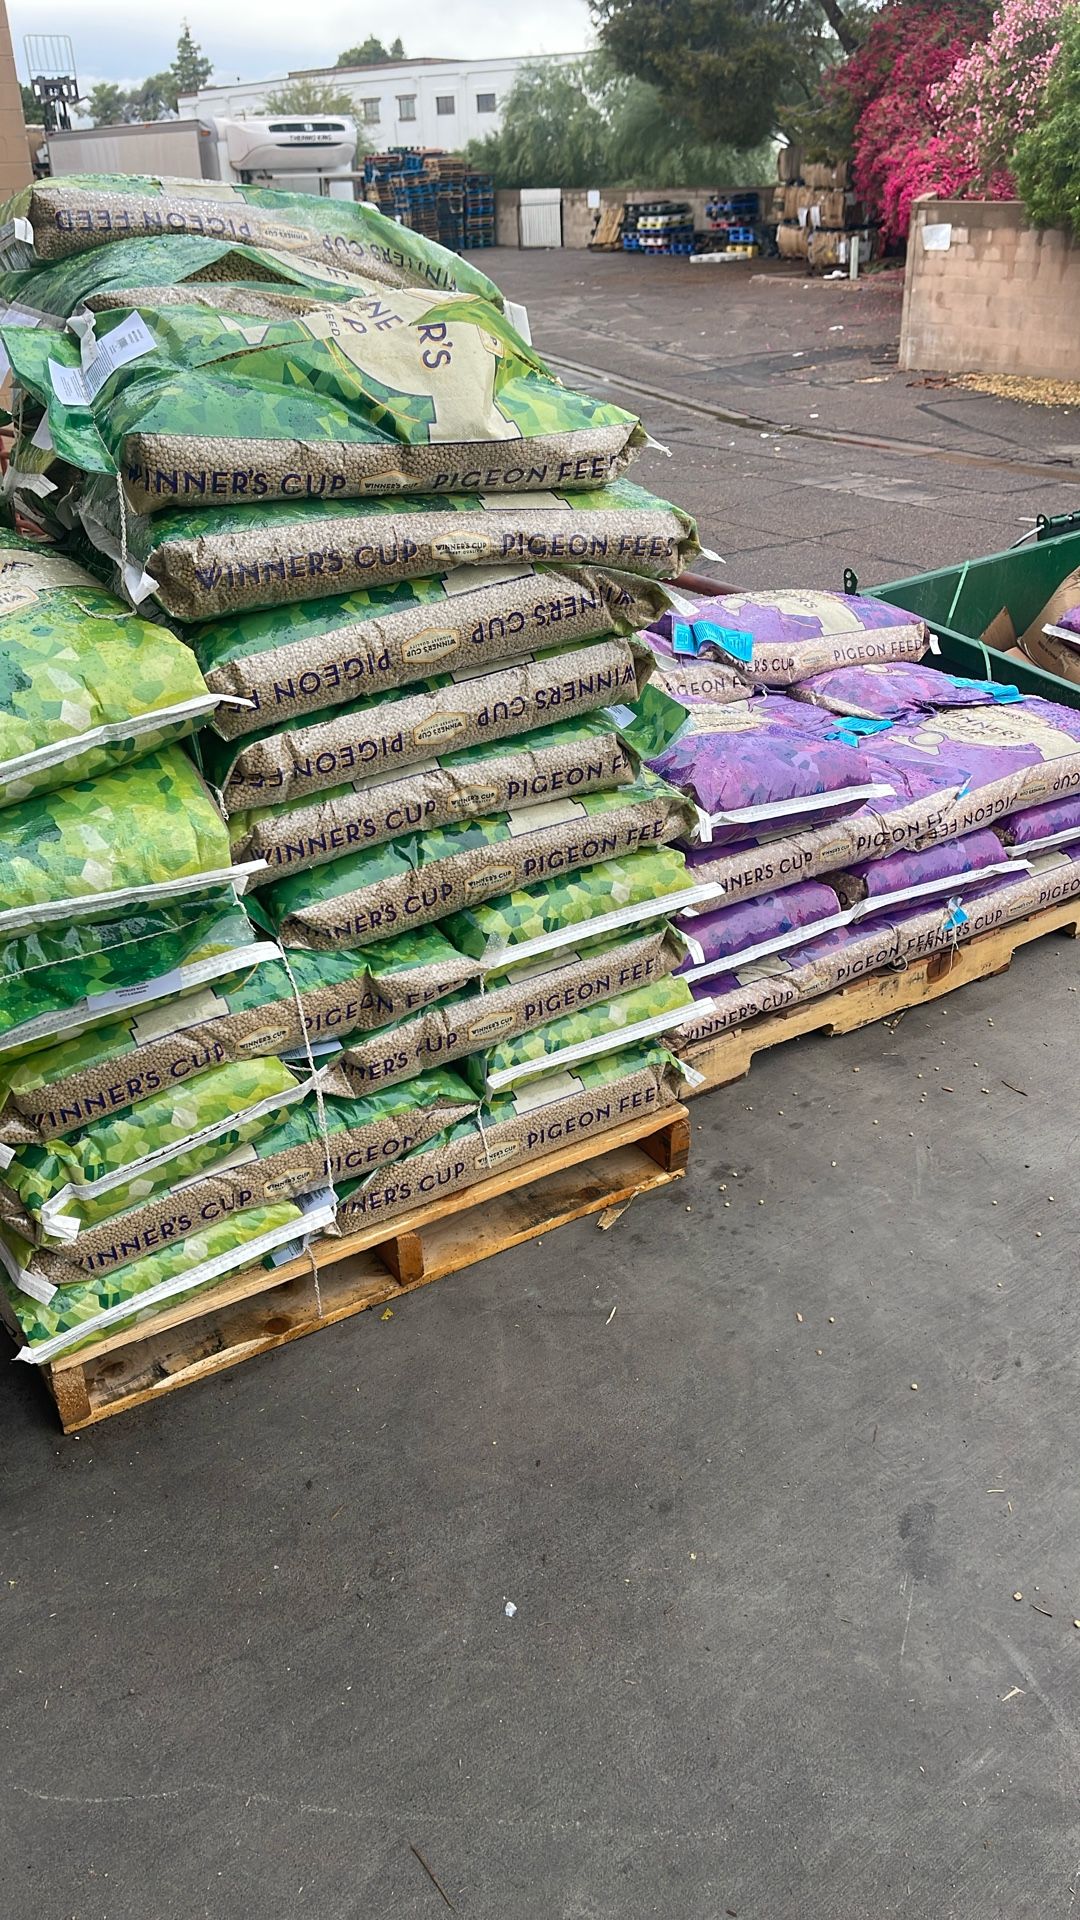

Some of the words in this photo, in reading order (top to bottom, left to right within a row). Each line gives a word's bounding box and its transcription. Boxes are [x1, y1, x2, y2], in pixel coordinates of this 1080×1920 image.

[55, 209, 130, 230] FEED
[143, 208, 251, 238] PIGEON
[322, 234, 364, 257] CUP
[128, 463, 268, 495] WINNER'S
[280, 473, 346, 495] CUP
[432, 464, 547, 489] PIGEON
[195, 545, 344, 590] WINNER'S
[354, 538, 418, 569] CUP
[502, 534, 607, 557] PIGEON
[471, 611, 525, 643] CUP
[406, 648, 422, 658] CUP
[423, 638, 457, 653] WINNER'S
[772, 658, 795, 671] CUP
[834, 644, 885, 662] PIGEON
[891, 639, 923, 655] FEED
[273, 649, 392, 704] PIGEON
[535, 663, 636, 710] WINNER'S
[477, 696, 526, 727] CUP
[417, 730, 433, 740] CUP
[432, 722, 463, 737] WINNER'S
[292, 732, 404, 777] PIGEON
[385, 800, 436, 830] CUP
[508, 761, 602, 800] PIGEON
[1053, 772, 1080, 790] CUP
[481, 792, 495, 800] CUP
[403, 883, 453, 914] CUP
[524, 835, 617, 876] PIGEON
[498, 870, 512, 879] CUP
[780, 852, 813, 875] CUP
[974, 909, 1002, 930] CUP
[762, 990, 794, 1011] CUP
[837, 944, 899, 981] PIGEON
[525, 975, 610, 1020] PIGEON
[471, 1021, 500, 1036] WINNER'S
[500, 1016, 513, 1025] CUP
[170, 1041, 225, 1078] CUP
[419, 1162, 465, 1192] CUP
[527, 1104, 610, 1148] PIGEON
[619, 1086, 660, 1114] FEE
[505, 1144, 516, 1154] CUP
[297, 1172, 311, 1182] CUP
[201, 1190, 252, 1219] CUP
